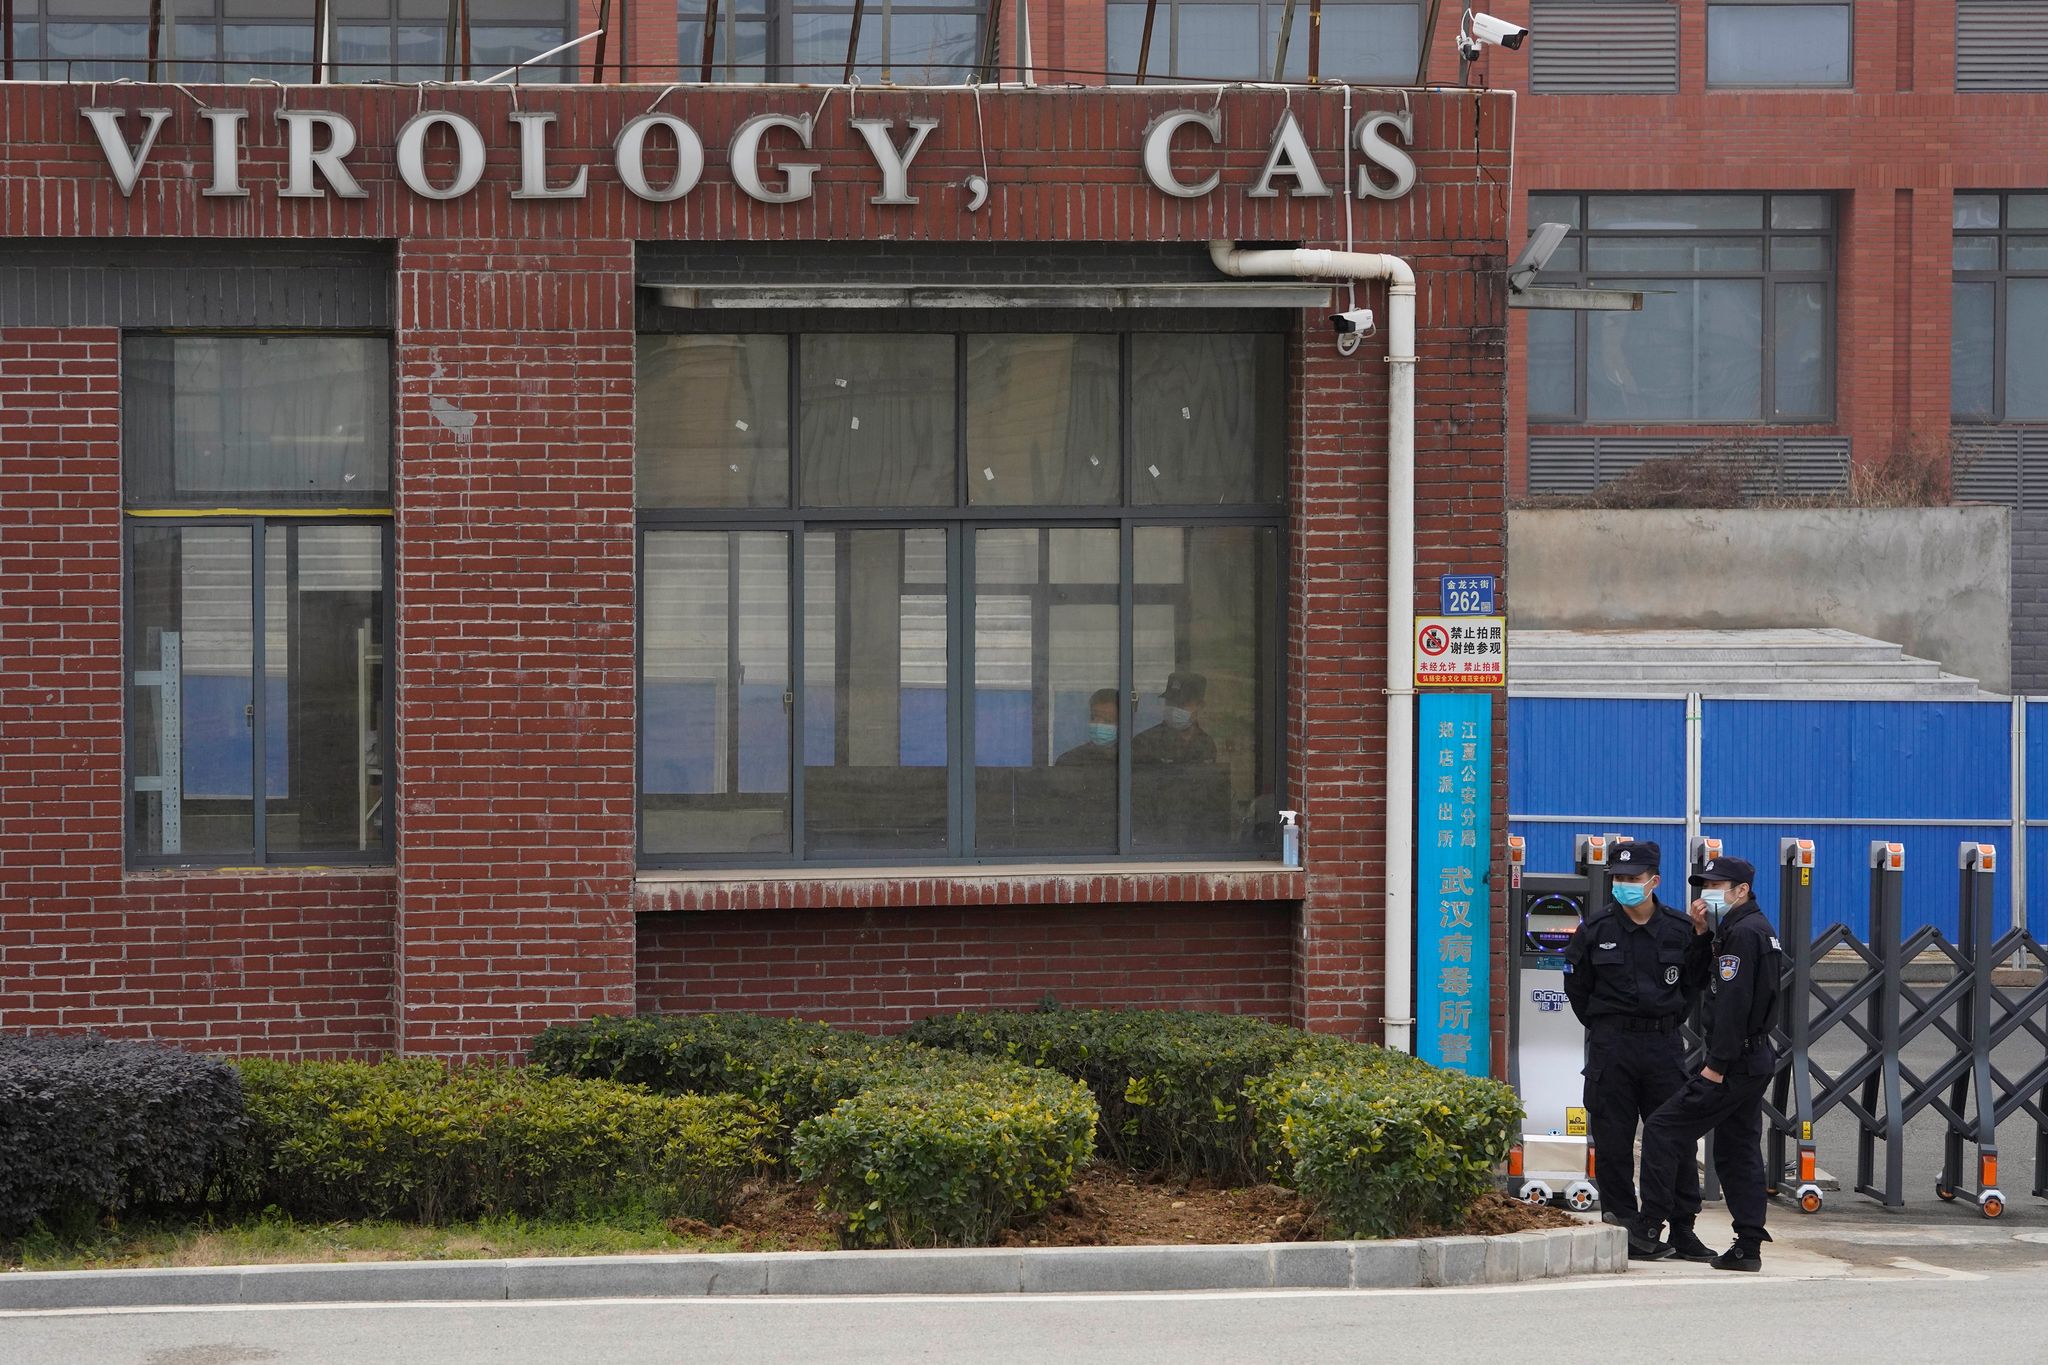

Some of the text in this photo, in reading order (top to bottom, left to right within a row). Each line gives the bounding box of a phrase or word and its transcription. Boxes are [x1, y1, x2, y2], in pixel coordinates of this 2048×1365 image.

[80, 106, 1417, 212] VIROLOGY, CAS
[1447, 580, 1489, 589] 金龙大街
[1450, 591, 1480, 612] 262
[1451, 626, 1501, 639] 禁止拍照
[1451, 641, 1501, 654] 谢绝参观
[1420, 662, 1500, 672] 未经允许 禁止拍摄
[1438, 721, 1455, 848] 郑店派出所
[1461, 721, 1477, 848] 江夏公安分局
[1438, 866, 1473, 1075] 武汉病毒所警
